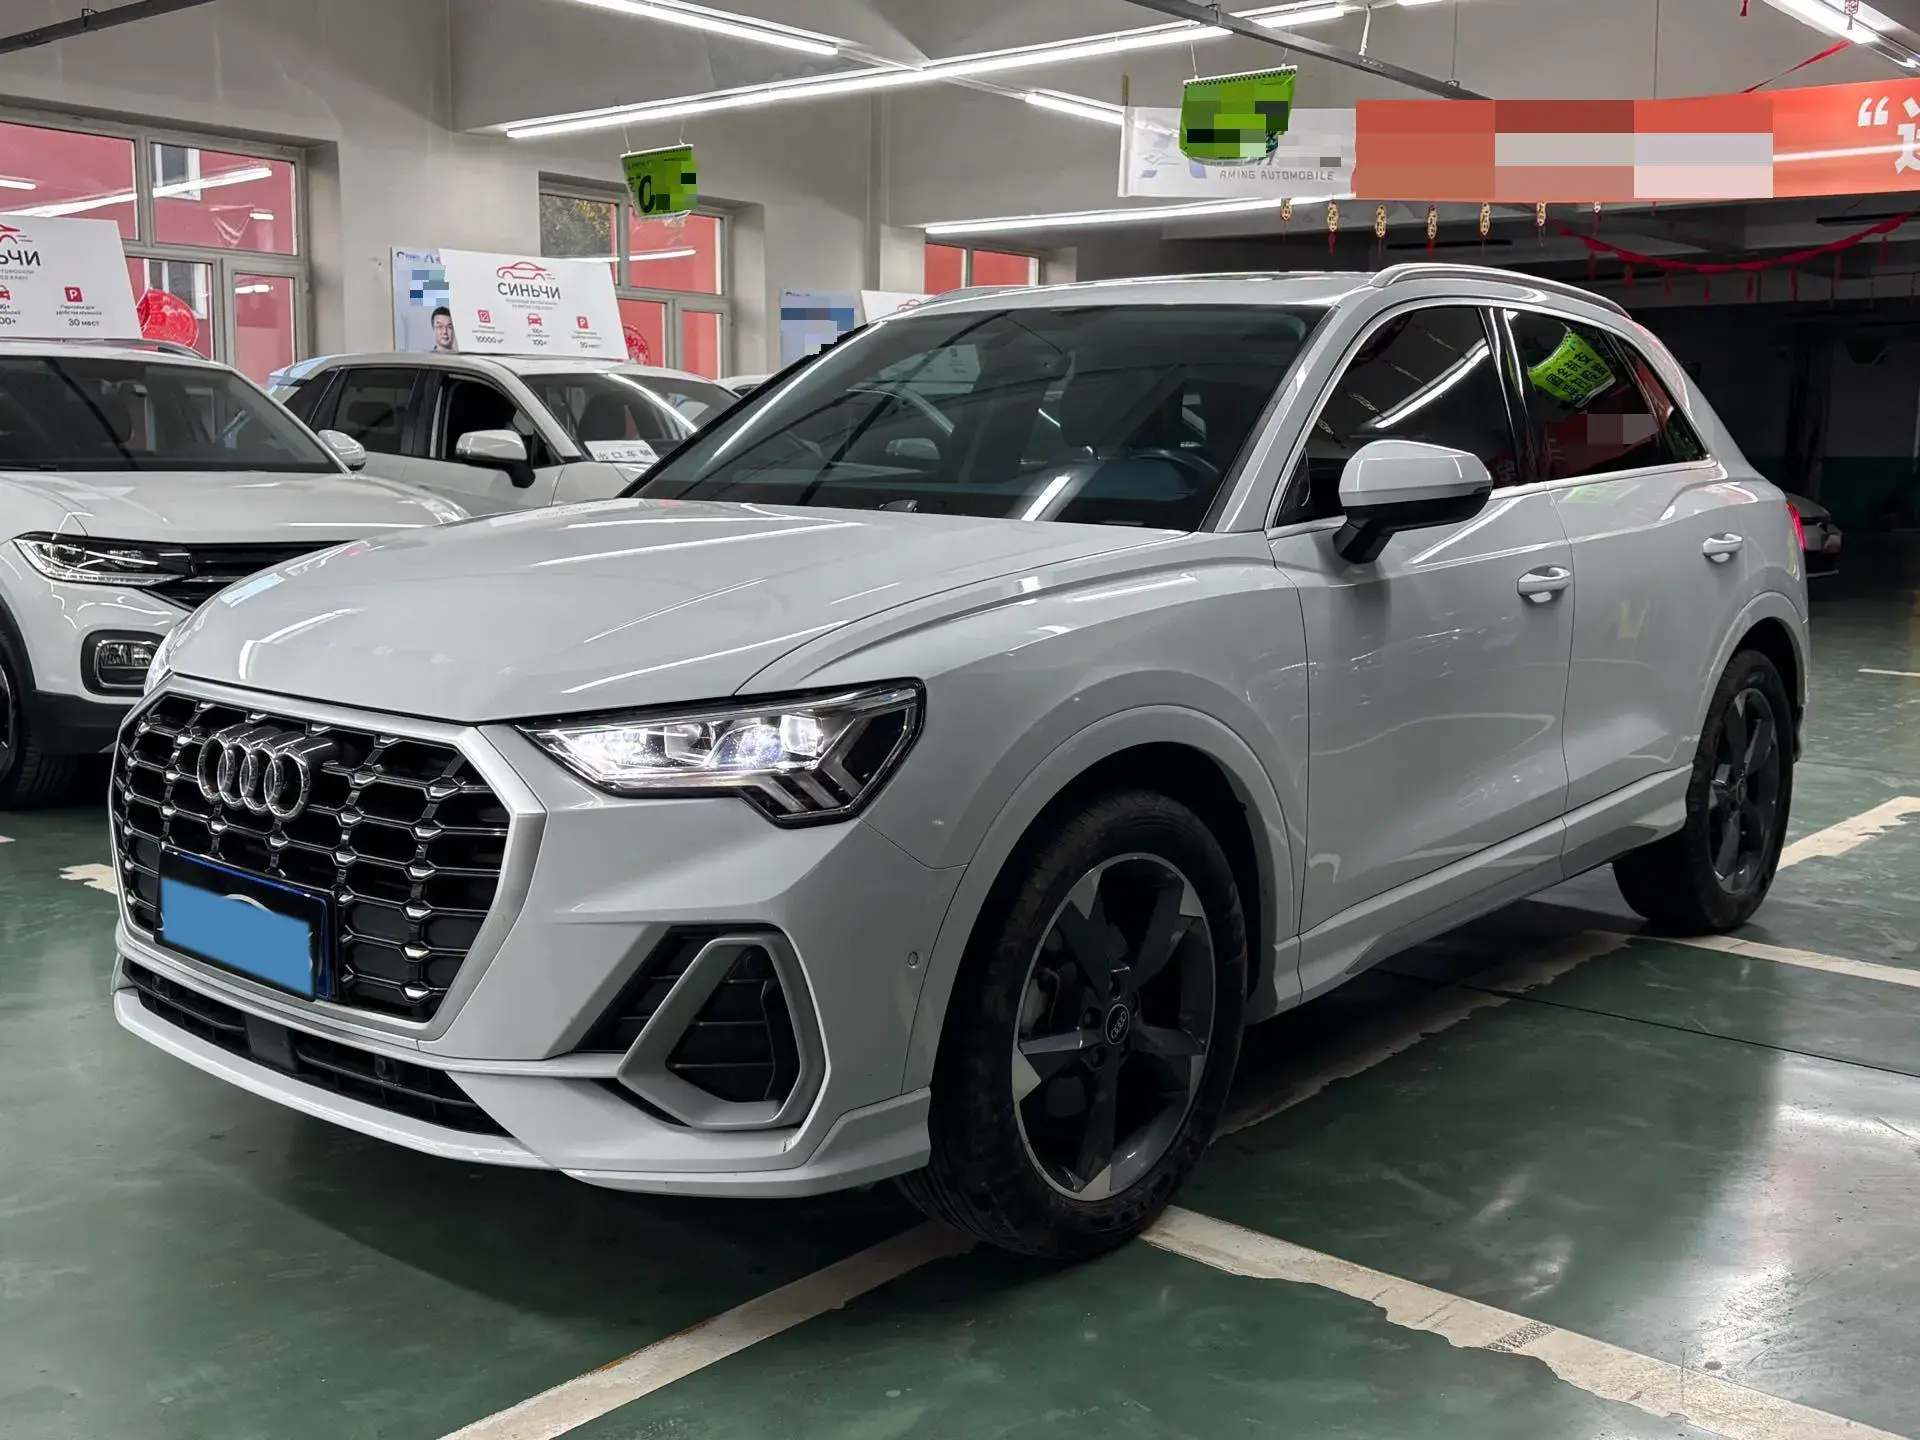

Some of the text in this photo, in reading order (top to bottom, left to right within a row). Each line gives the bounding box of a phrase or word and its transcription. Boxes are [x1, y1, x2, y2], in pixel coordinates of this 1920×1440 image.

[1220, 169, 1336, 182] AMING AUTOMOBILE
[497, 282, 561, 300] СИНЬЧИ
[68, 318, 80, 327] 30
